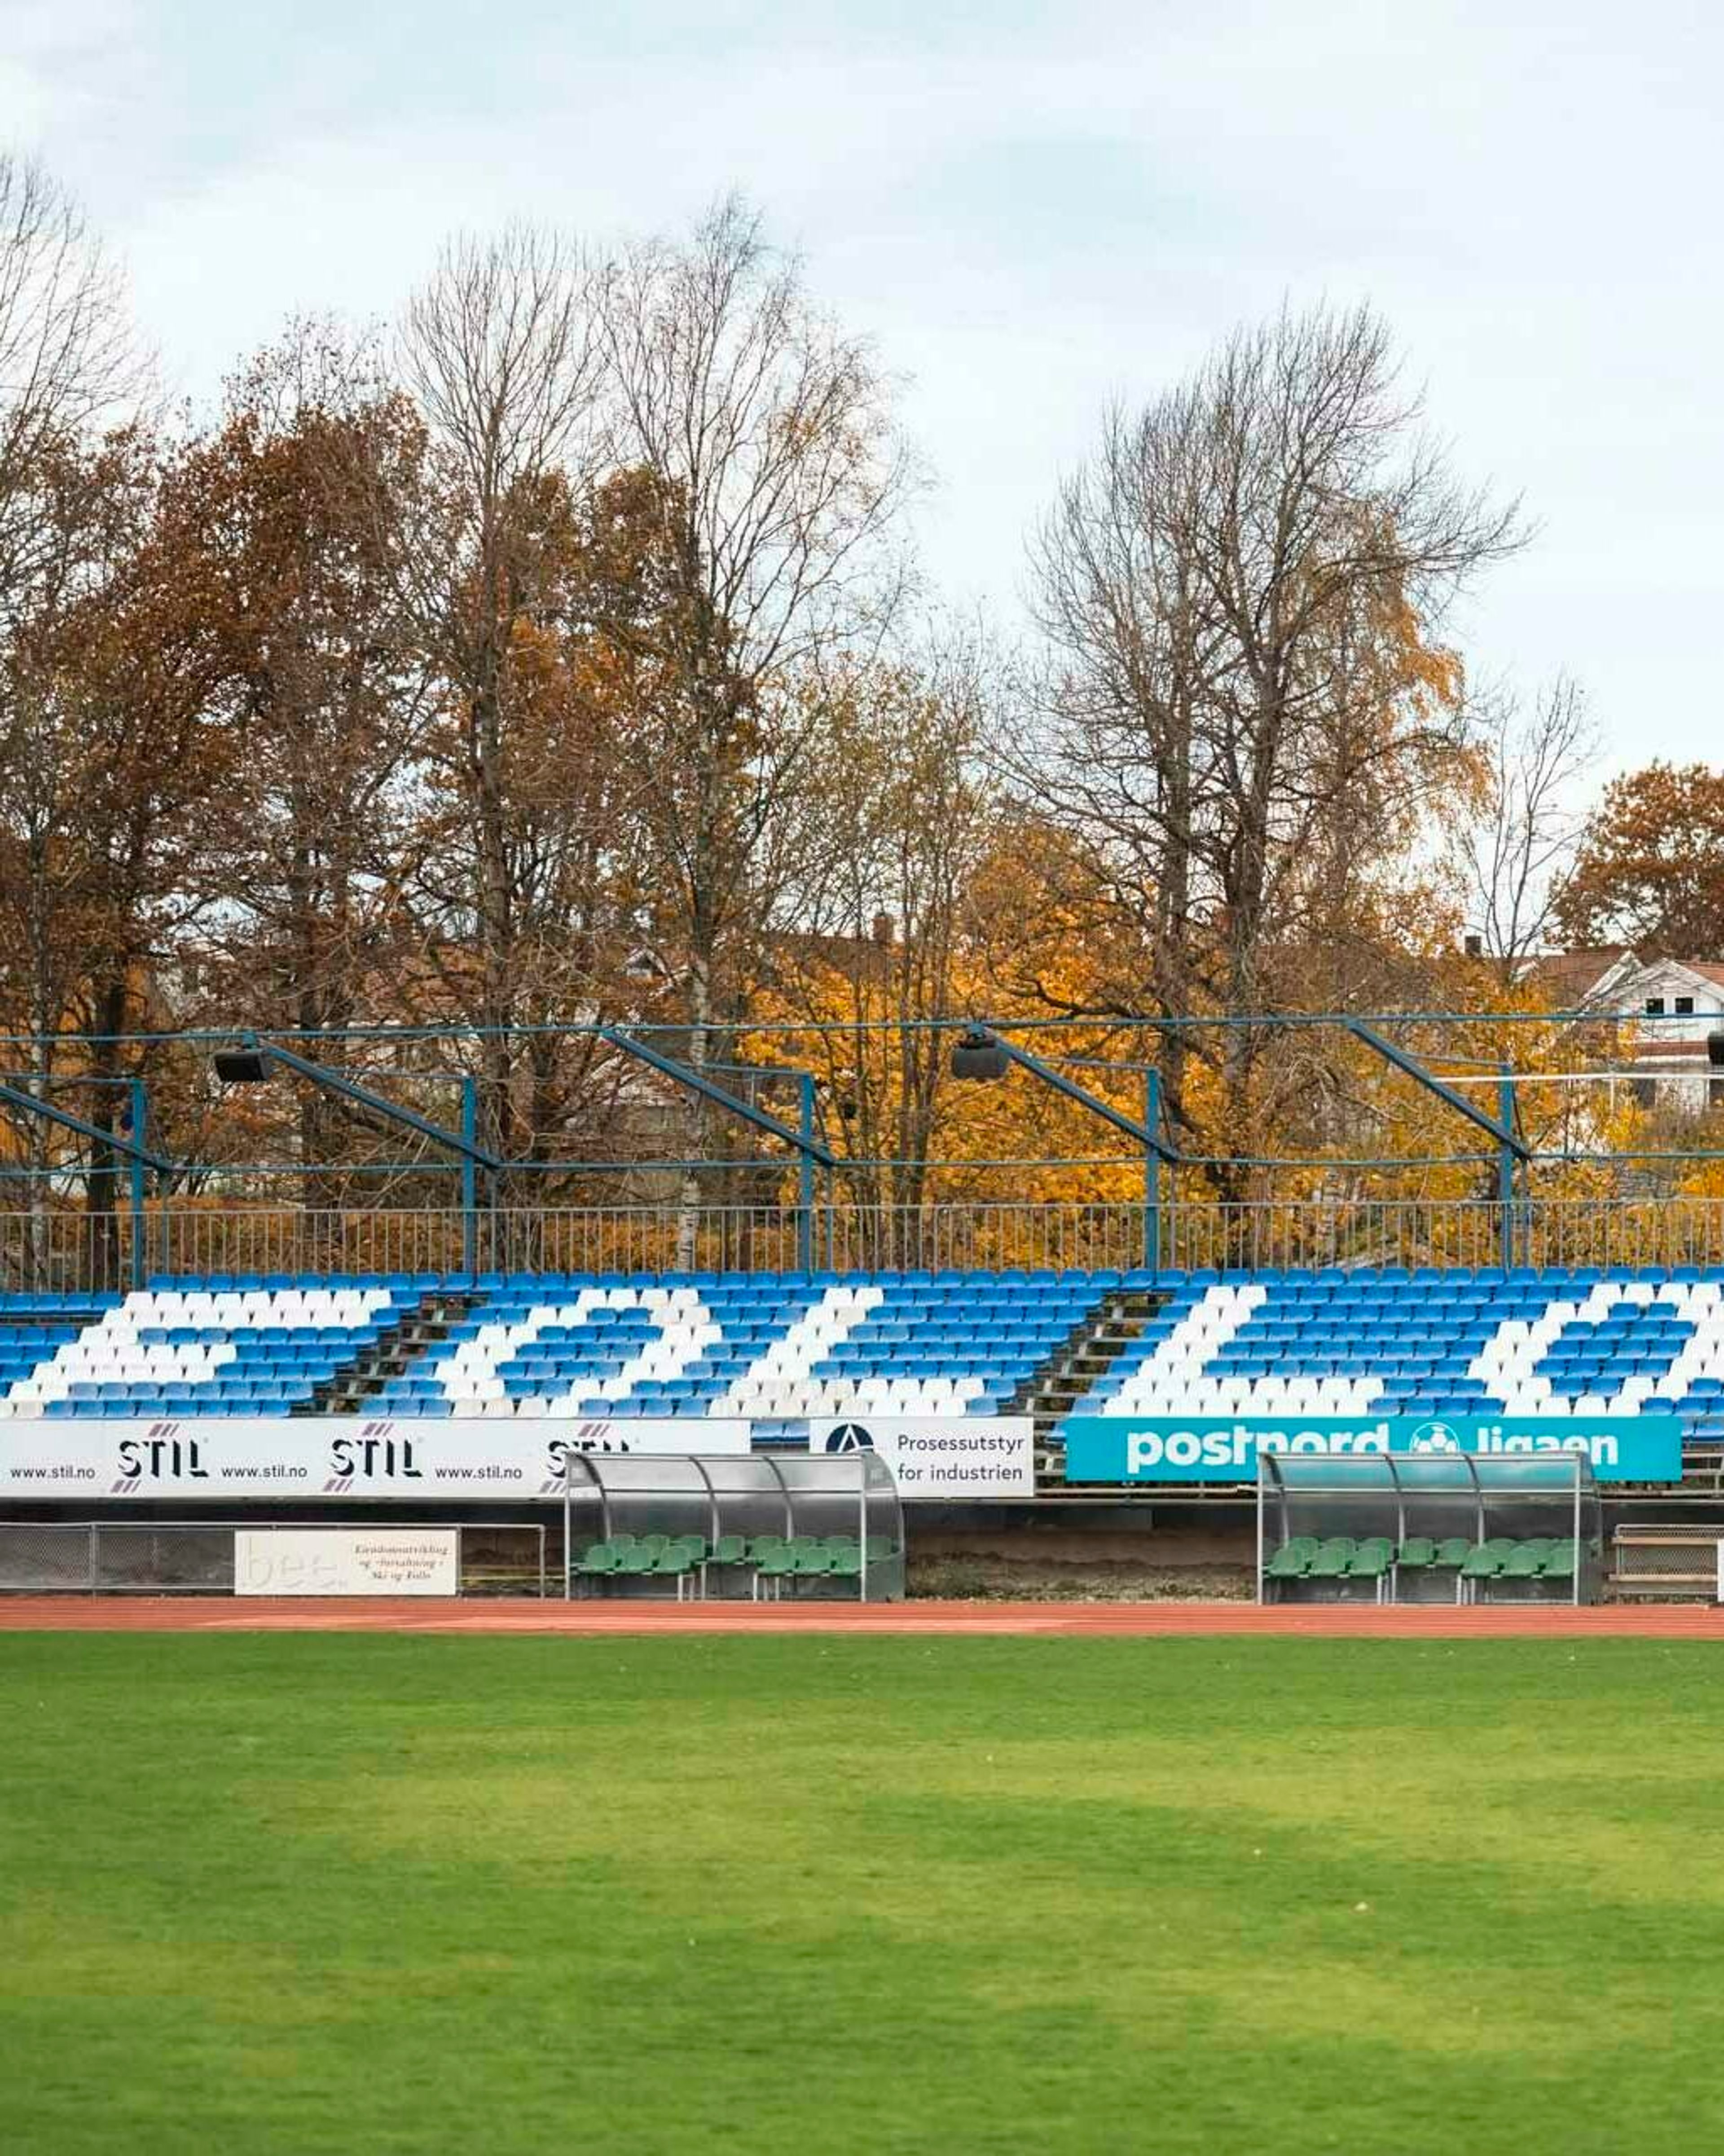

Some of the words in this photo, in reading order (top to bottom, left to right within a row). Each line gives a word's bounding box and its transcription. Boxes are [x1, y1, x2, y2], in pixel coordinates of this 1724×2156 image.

[10, 1465, 95, 1479] www.stil.no
[119, 1440, 209, 1477] STIL
[222, 1465, 307, 1478] www.stil.no
[330, 1439, 422, 1477] STIL
[436, 1466, 522, 1479] www.stil.no
[898, 1435, 1024, 1455] Prosessutstyr
[1127, 1423, 1390, 1474] postnord
[898, 1464, 923, 1480] for
[931, 1464, 1022, 1480] industrien
